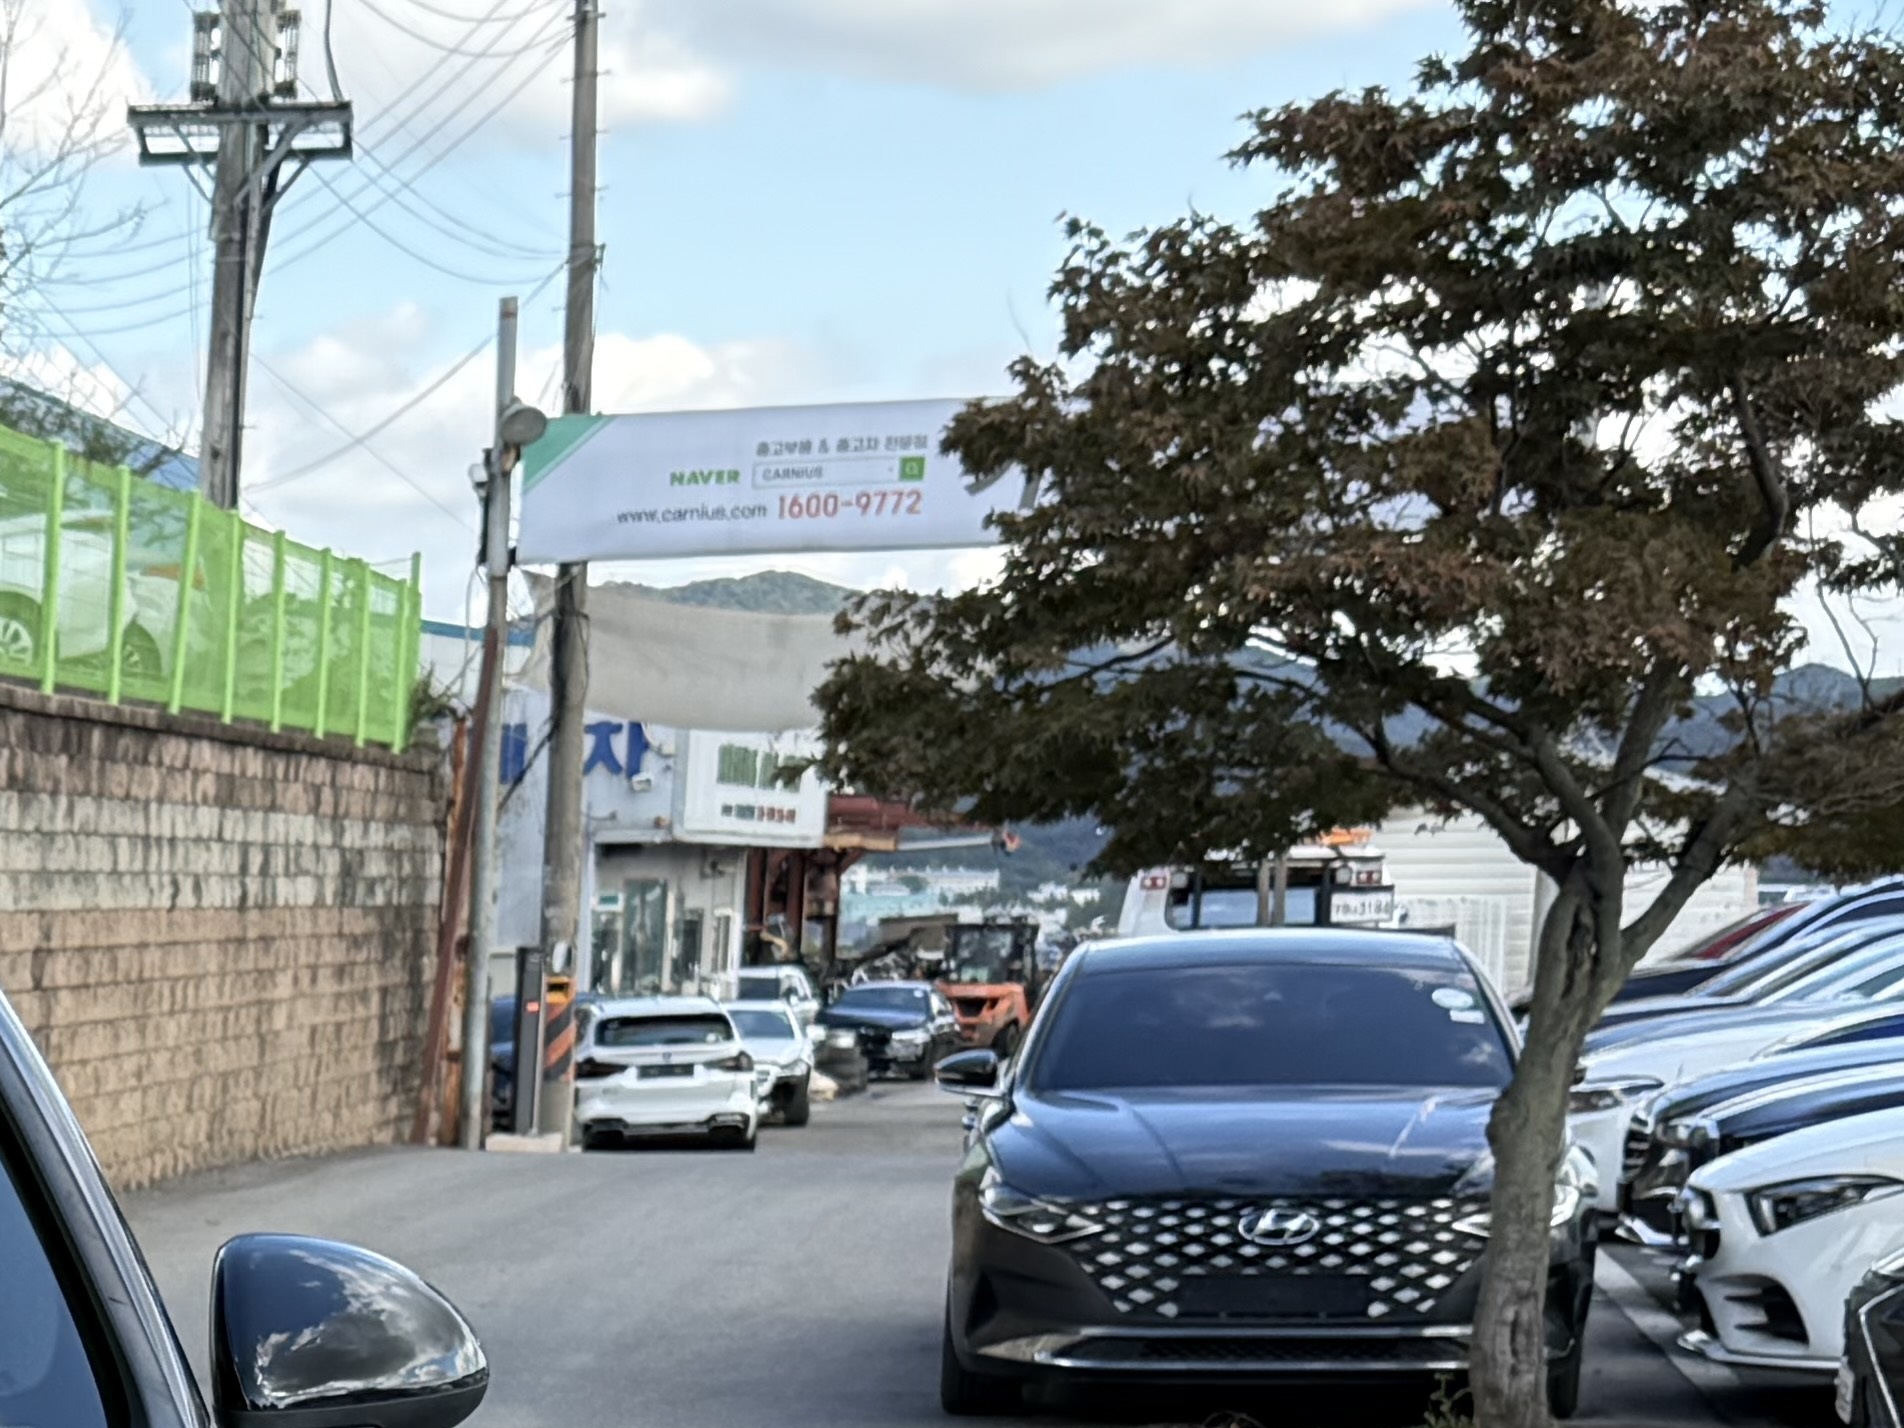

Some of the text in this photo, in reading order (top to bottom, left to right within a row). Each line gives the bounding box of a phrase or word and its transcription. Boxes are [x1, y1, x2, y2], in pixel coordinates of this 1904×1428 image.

[670, 466, 824, 487] NAVER CARNIUS
[617, 489, 922, 524] www.carnius.com 1600-9772
